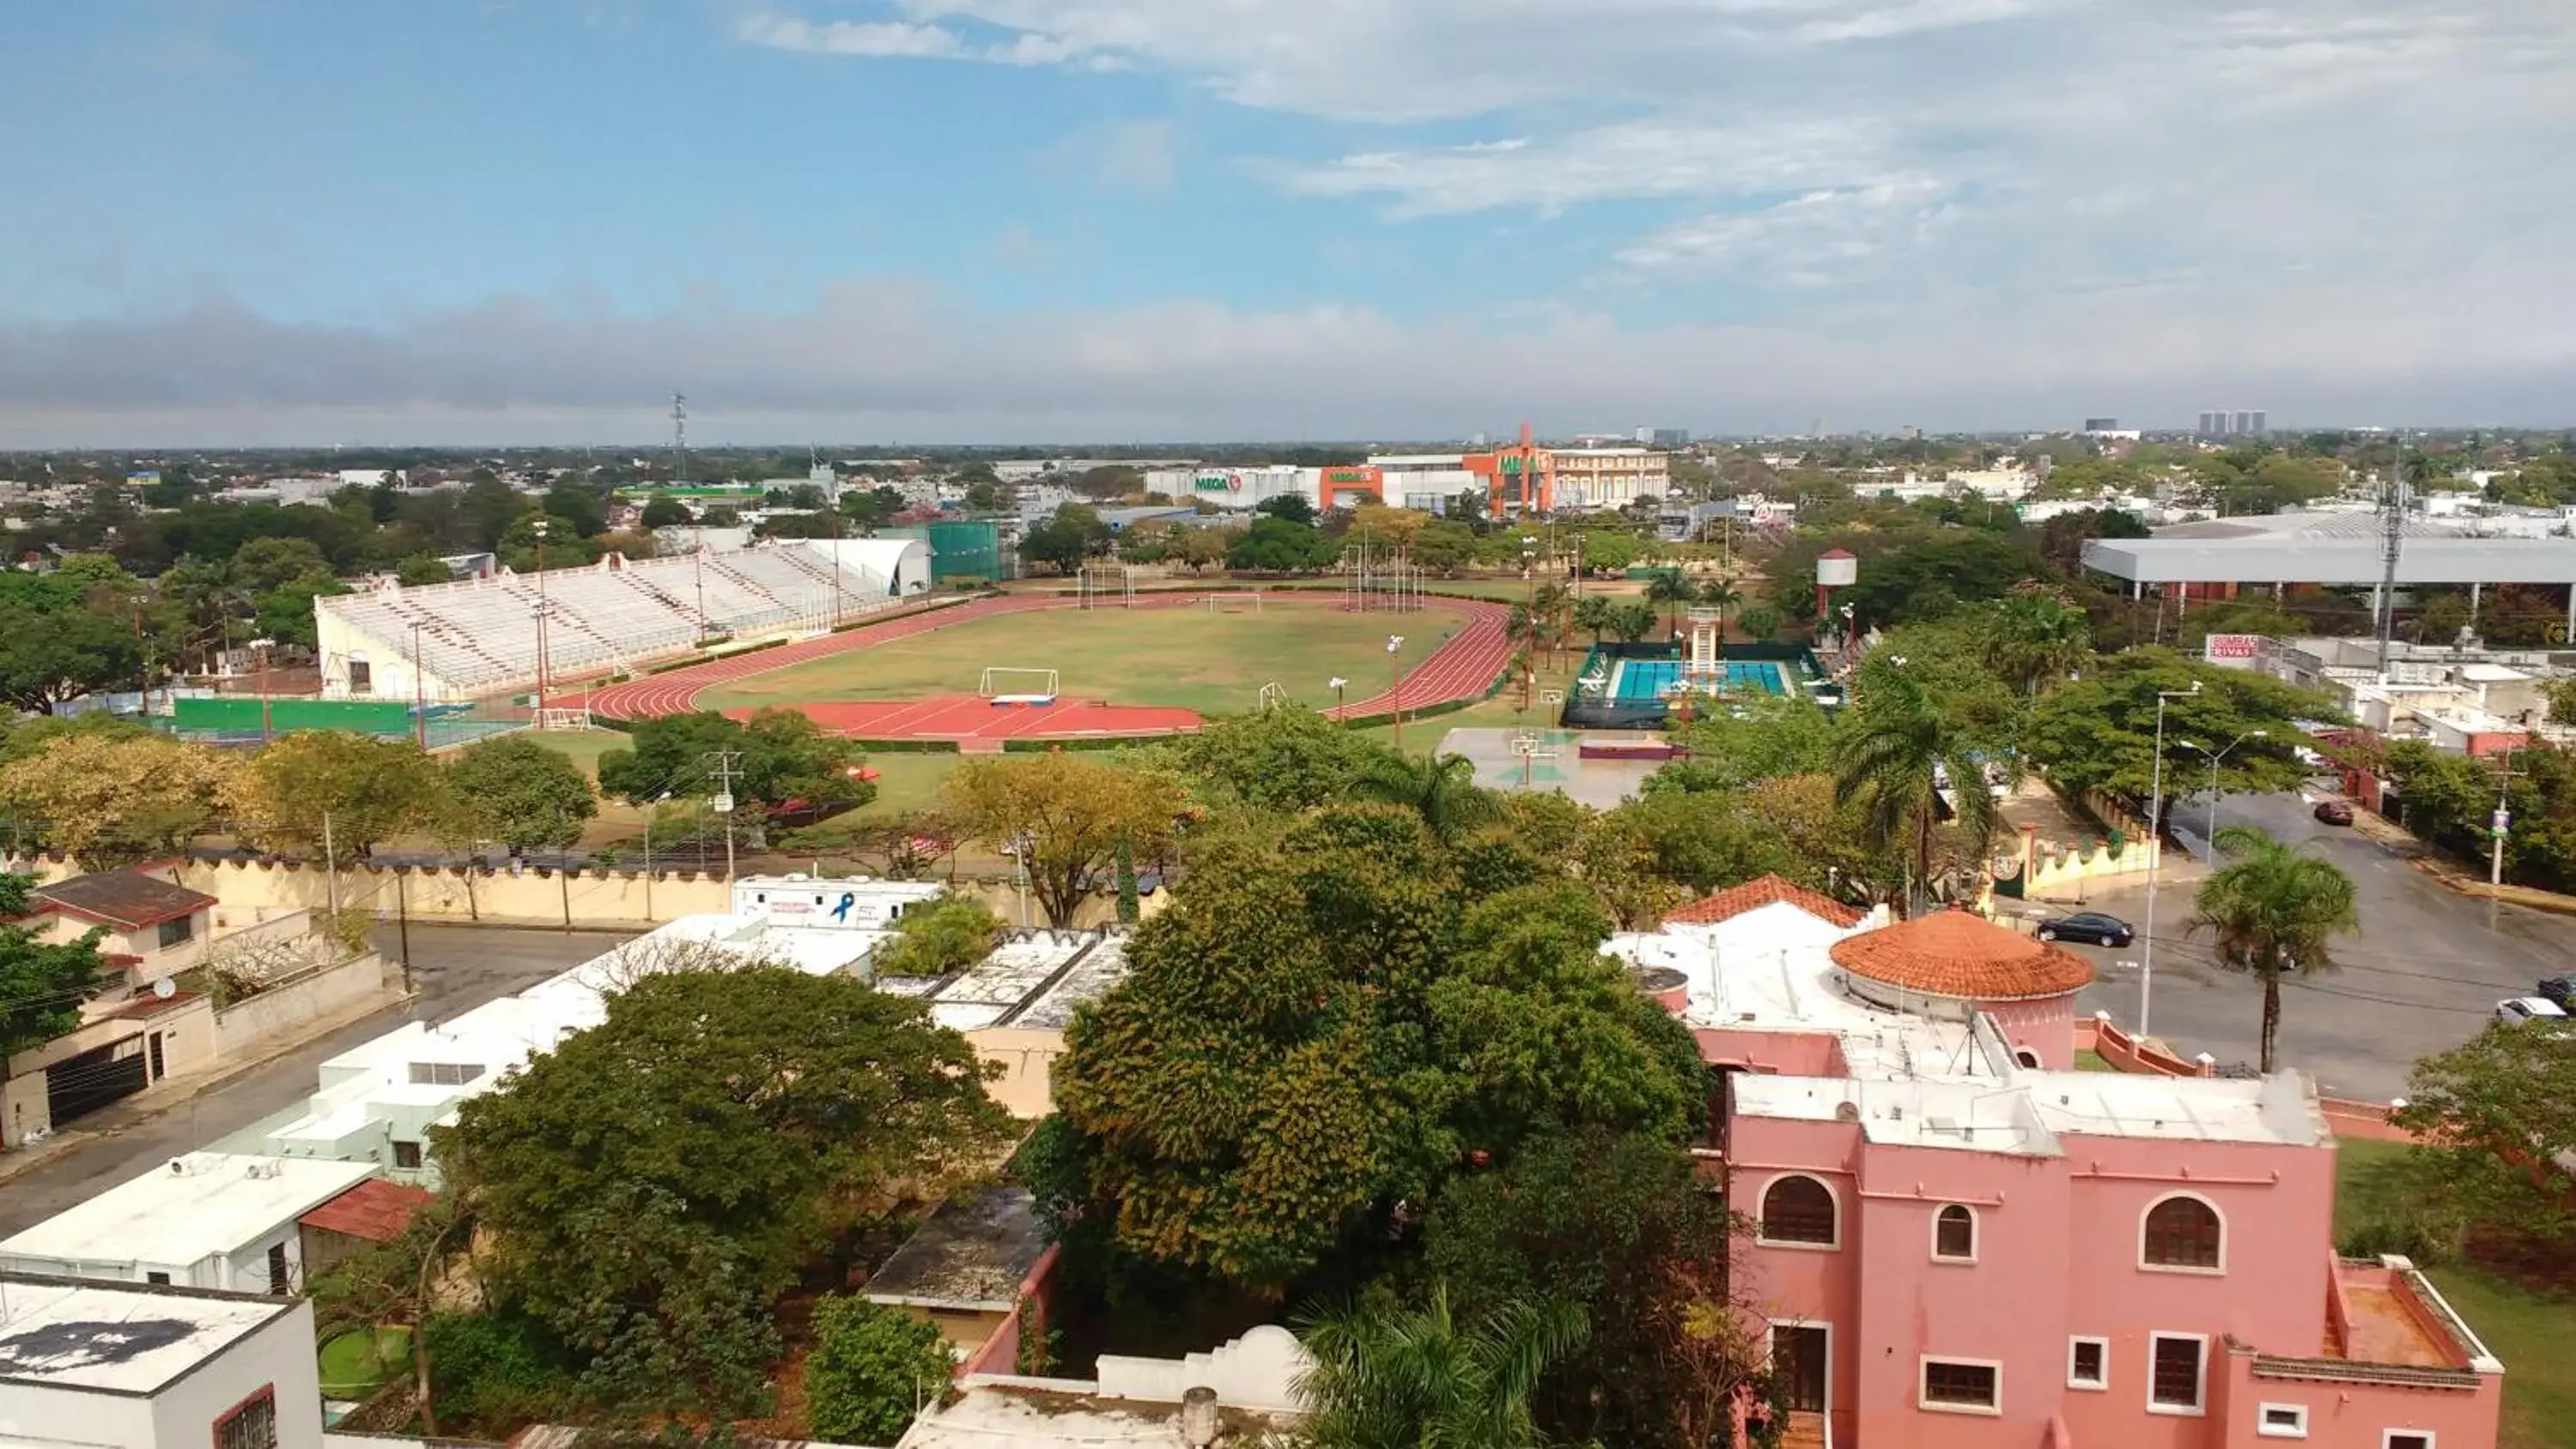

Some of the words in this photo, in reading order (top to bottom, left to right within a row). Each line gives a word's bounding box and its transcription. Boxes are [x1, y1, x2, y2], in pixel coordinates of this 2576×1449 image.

[1498, 455, 1540, 475] MEA
[1194, 477, 1229, 490] MEGA
[2215, 647, 2251, 657] RIVAS
